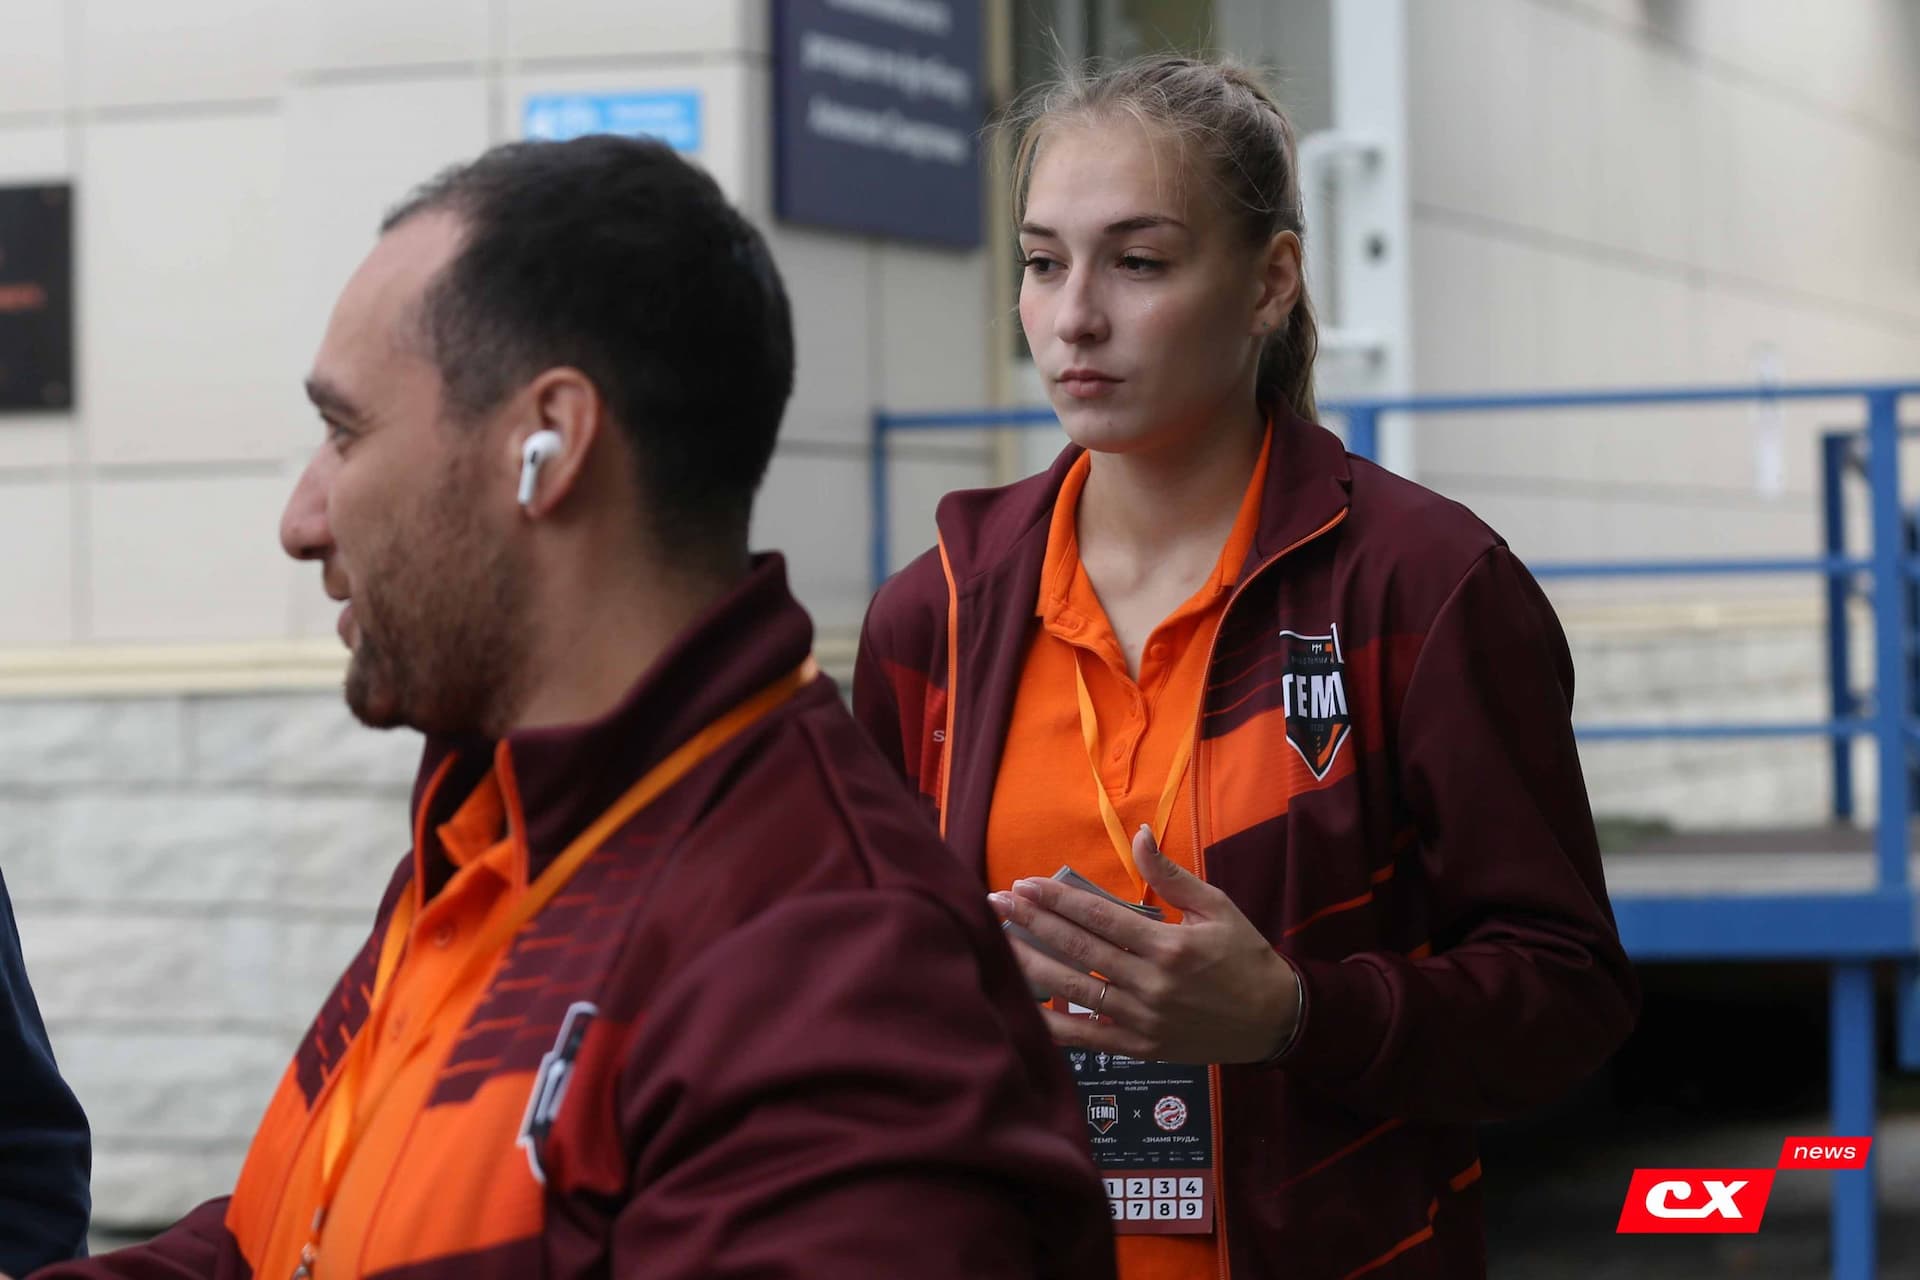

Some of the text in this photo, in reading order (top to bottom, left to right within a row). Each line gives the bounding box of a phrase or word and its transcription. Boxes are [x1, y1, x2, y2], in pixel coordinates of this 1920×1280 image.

[1090, 1106, 1115, 1119] ТЕМП
[1108, 1180, 1197, 1195] 1 2 3 4
[1133, 1203, 1143, 1216] 7
[1160, 1203, 1170, 1216] 8
[1186, 1202, 1196, 1216] 9
